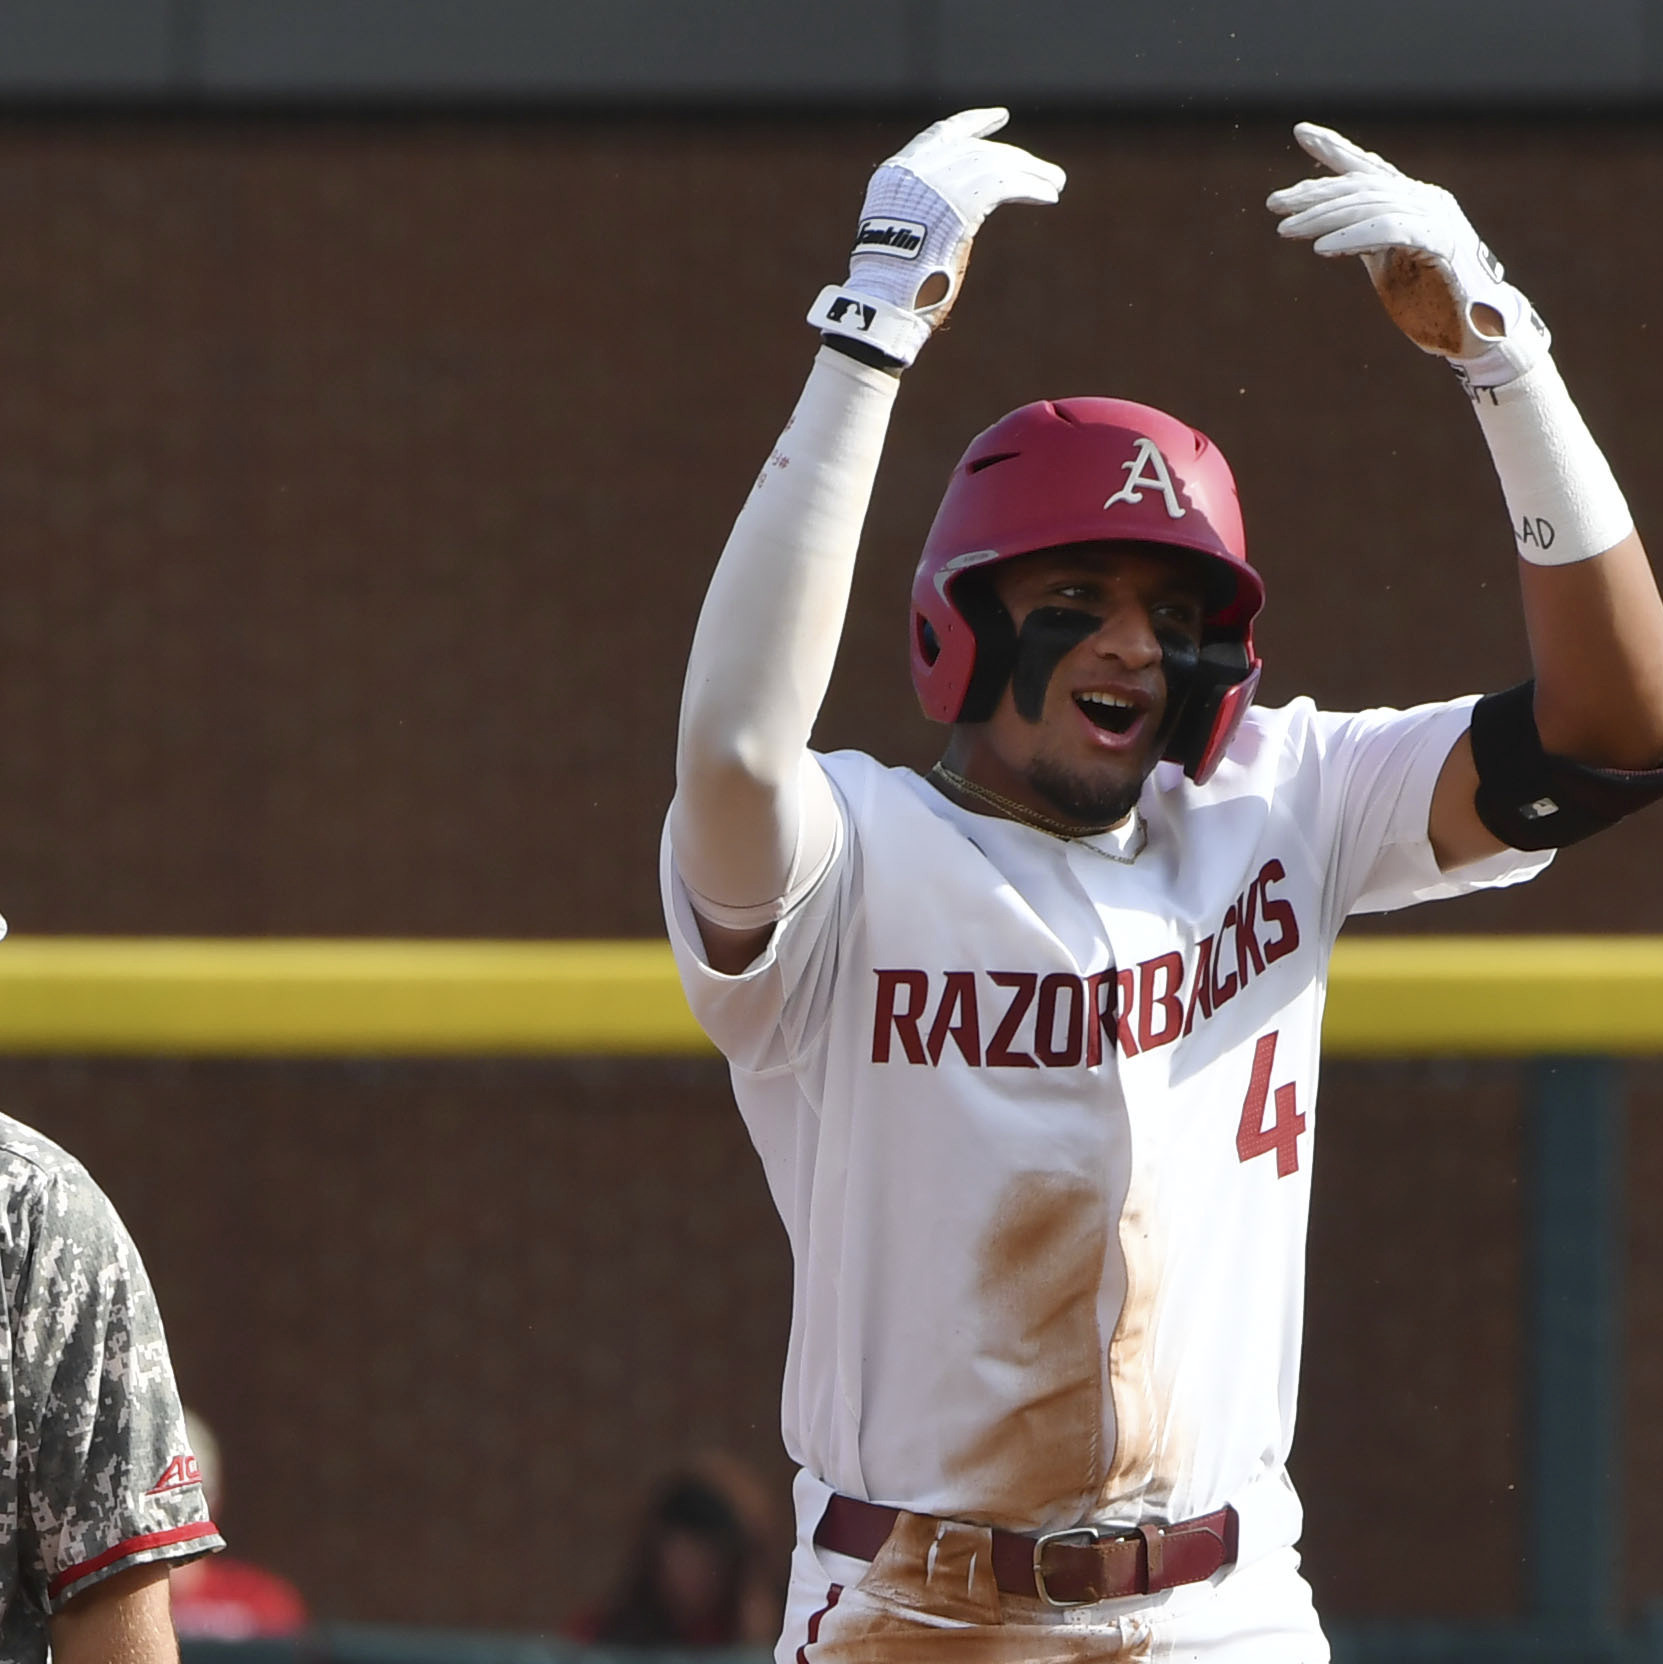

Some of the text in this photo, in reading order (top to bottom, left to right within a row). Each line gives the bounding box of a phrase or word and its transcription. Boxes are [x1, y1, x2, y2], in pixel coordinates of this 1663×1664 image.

[1103, 437, 1186, 518] A
[871, 858, 1300, 1069] RAZORBACKS
[1236, 1030, 1306, 1179] 4
